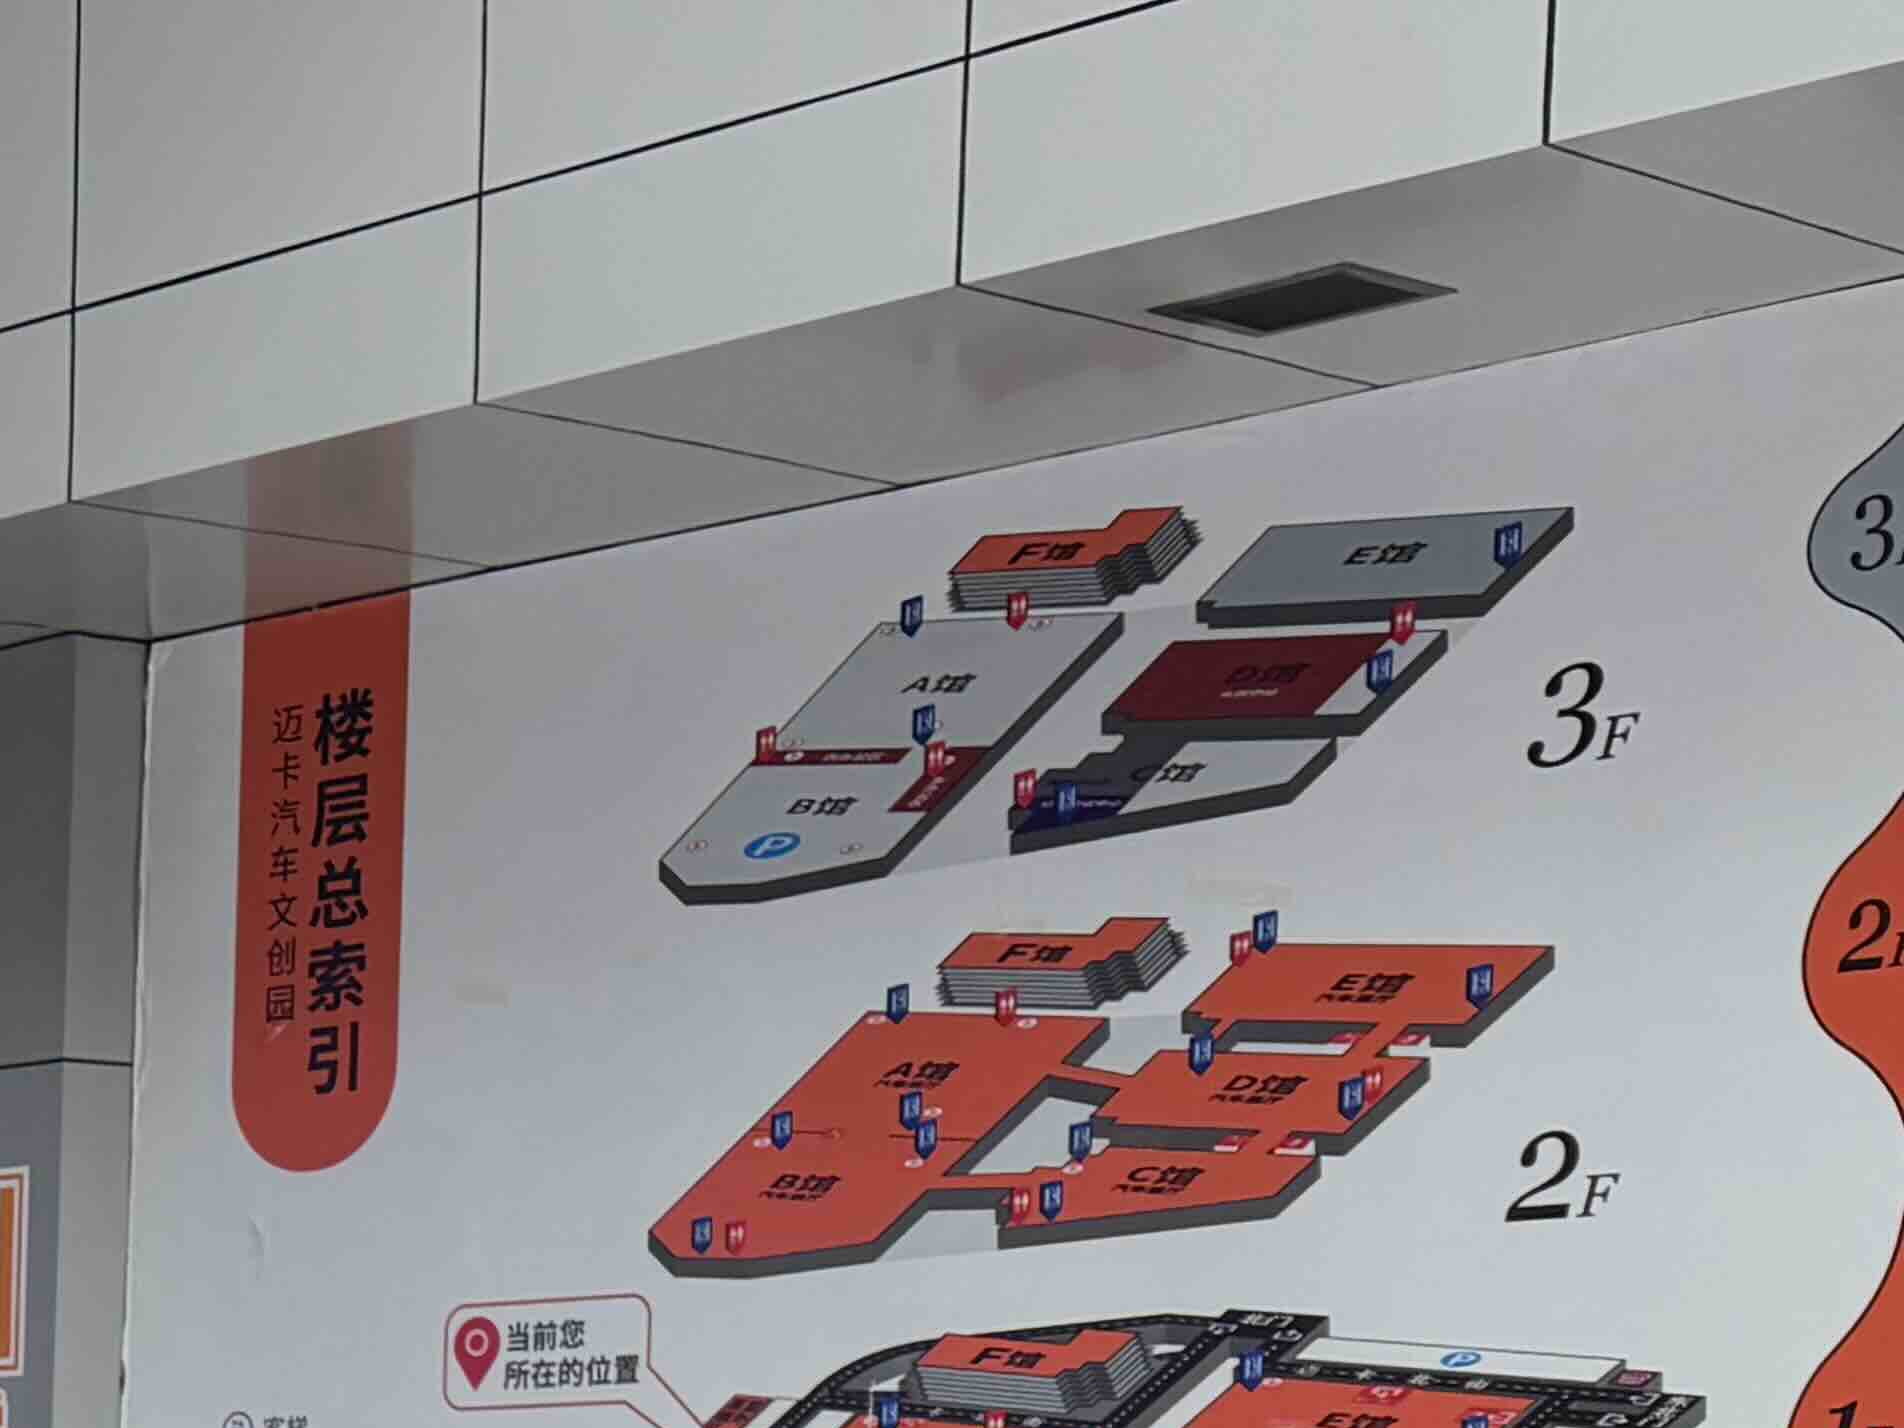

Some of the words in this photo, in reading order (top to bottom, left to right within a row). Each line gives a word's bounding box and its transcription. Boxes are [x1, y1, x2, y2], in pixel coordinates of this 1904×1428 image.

[1344, 542, 1428, 566] E馆
[901, 673, 977, 694] A馆
[1527, 662, 1641, 769] 3F
[787, 796, 857, 817] B馆
[264, 704, 305, 1026] 迈卡汽车文创园
[306, 687, 375, 1095] 楼层总索引
[1331, 972, 1415, 995] E馆
[882, 1061, 960, 1083] A馆
[1223, 1074, 1309, 1096] D馆
[769, 1174, 841, 1195] B馆
[1127, 1165, 1205, 1187] C馆
[1504, 1130, 1621, 1223] 2F
[507, 1320, 585, 1352] 当前您
[503, 1354, 639, 1391] 所在的位置
